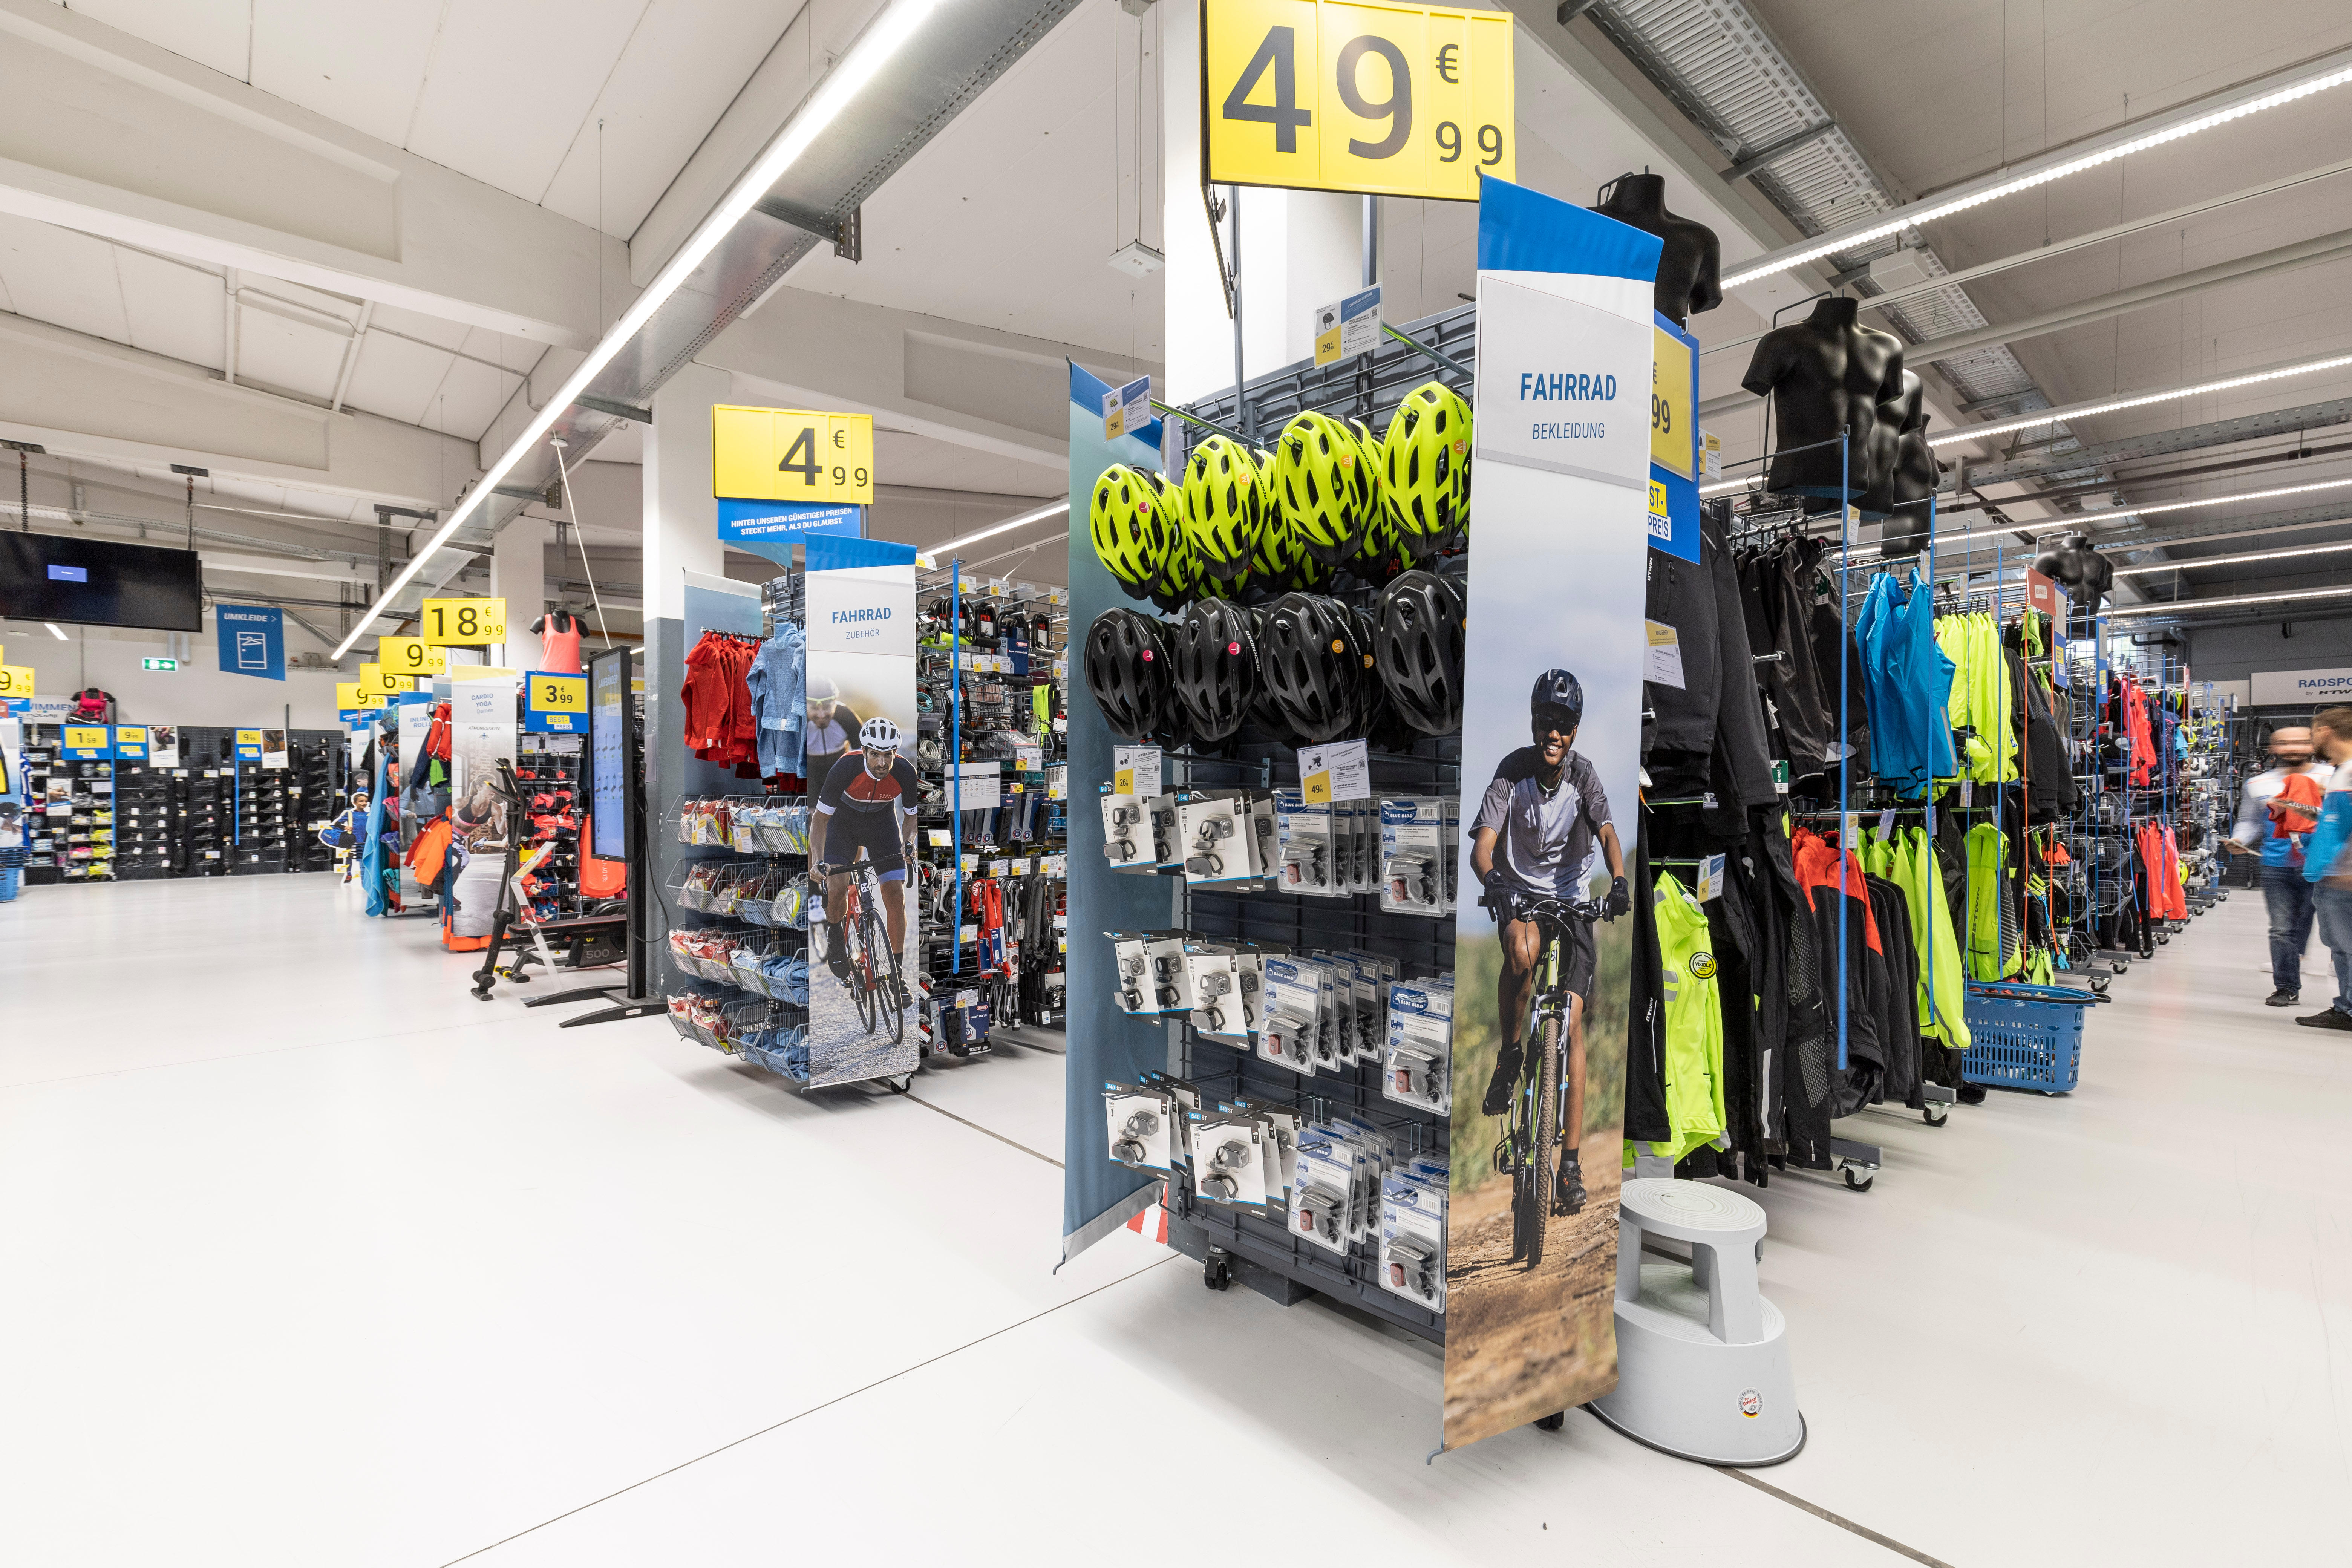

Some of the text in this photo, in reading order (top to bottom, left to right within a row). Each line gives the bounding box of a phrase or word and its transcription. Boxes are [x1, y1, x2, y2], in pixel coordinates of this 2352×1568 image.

[1222, 25, 1503, 165] 49 € 99
[1322, 342, 1330, 353] 29
[1521, 372, 1616, 401] FAHRRAD
[1110, 422, 1116, 431] 29
[1533, 422, 1605, 439] BEKLEIDUNG
[778, 427, 868, 487] 4 € 99
[1349, 434, 1374, 475] ROCKRIDER
[1249, 459, 1268, 500] ROCKRIDER
[1148, 488, 1171, 525] ROCKRIDER
[731, 508, 852, 527] HINTER UNSEREN GÜNSTIGEN PREISEN
[741, 526, 765, 535] STECKT
[789, 521, 801, 530] ALS
[813, 517, 843, 527] GLAUBST.
[1648, 515, 1669, 538] PREIS
[224, 613, 268, 622] UMKLEIDE
[431, 607, 503, 637] 18 € 99
[832, 607, 891, 624] FAHRRAD
[846, 628, 880, 640] ZUBEHÖR
[1336, 616, 1361, 655] ROCKRIDER
[407, 644, 423, 667] 9
[428, 658, 443, 667] 99
[1153, 633, 1172, 669] ROCKRIDER
[1245, 630, 1261, 672] ROCKRIDER
[383, 673, 396, 689] 6
[357, 688, 368, 704] 9
[545, 685, 557, 703] 3
[560, 694, 573, 703] 99
[76, 733, 83, 743] 1
[1311, 784, 1320, 793] 49
[586, 949, 609, 959] 500
[1743, 1396, 1757, 1406] Original
